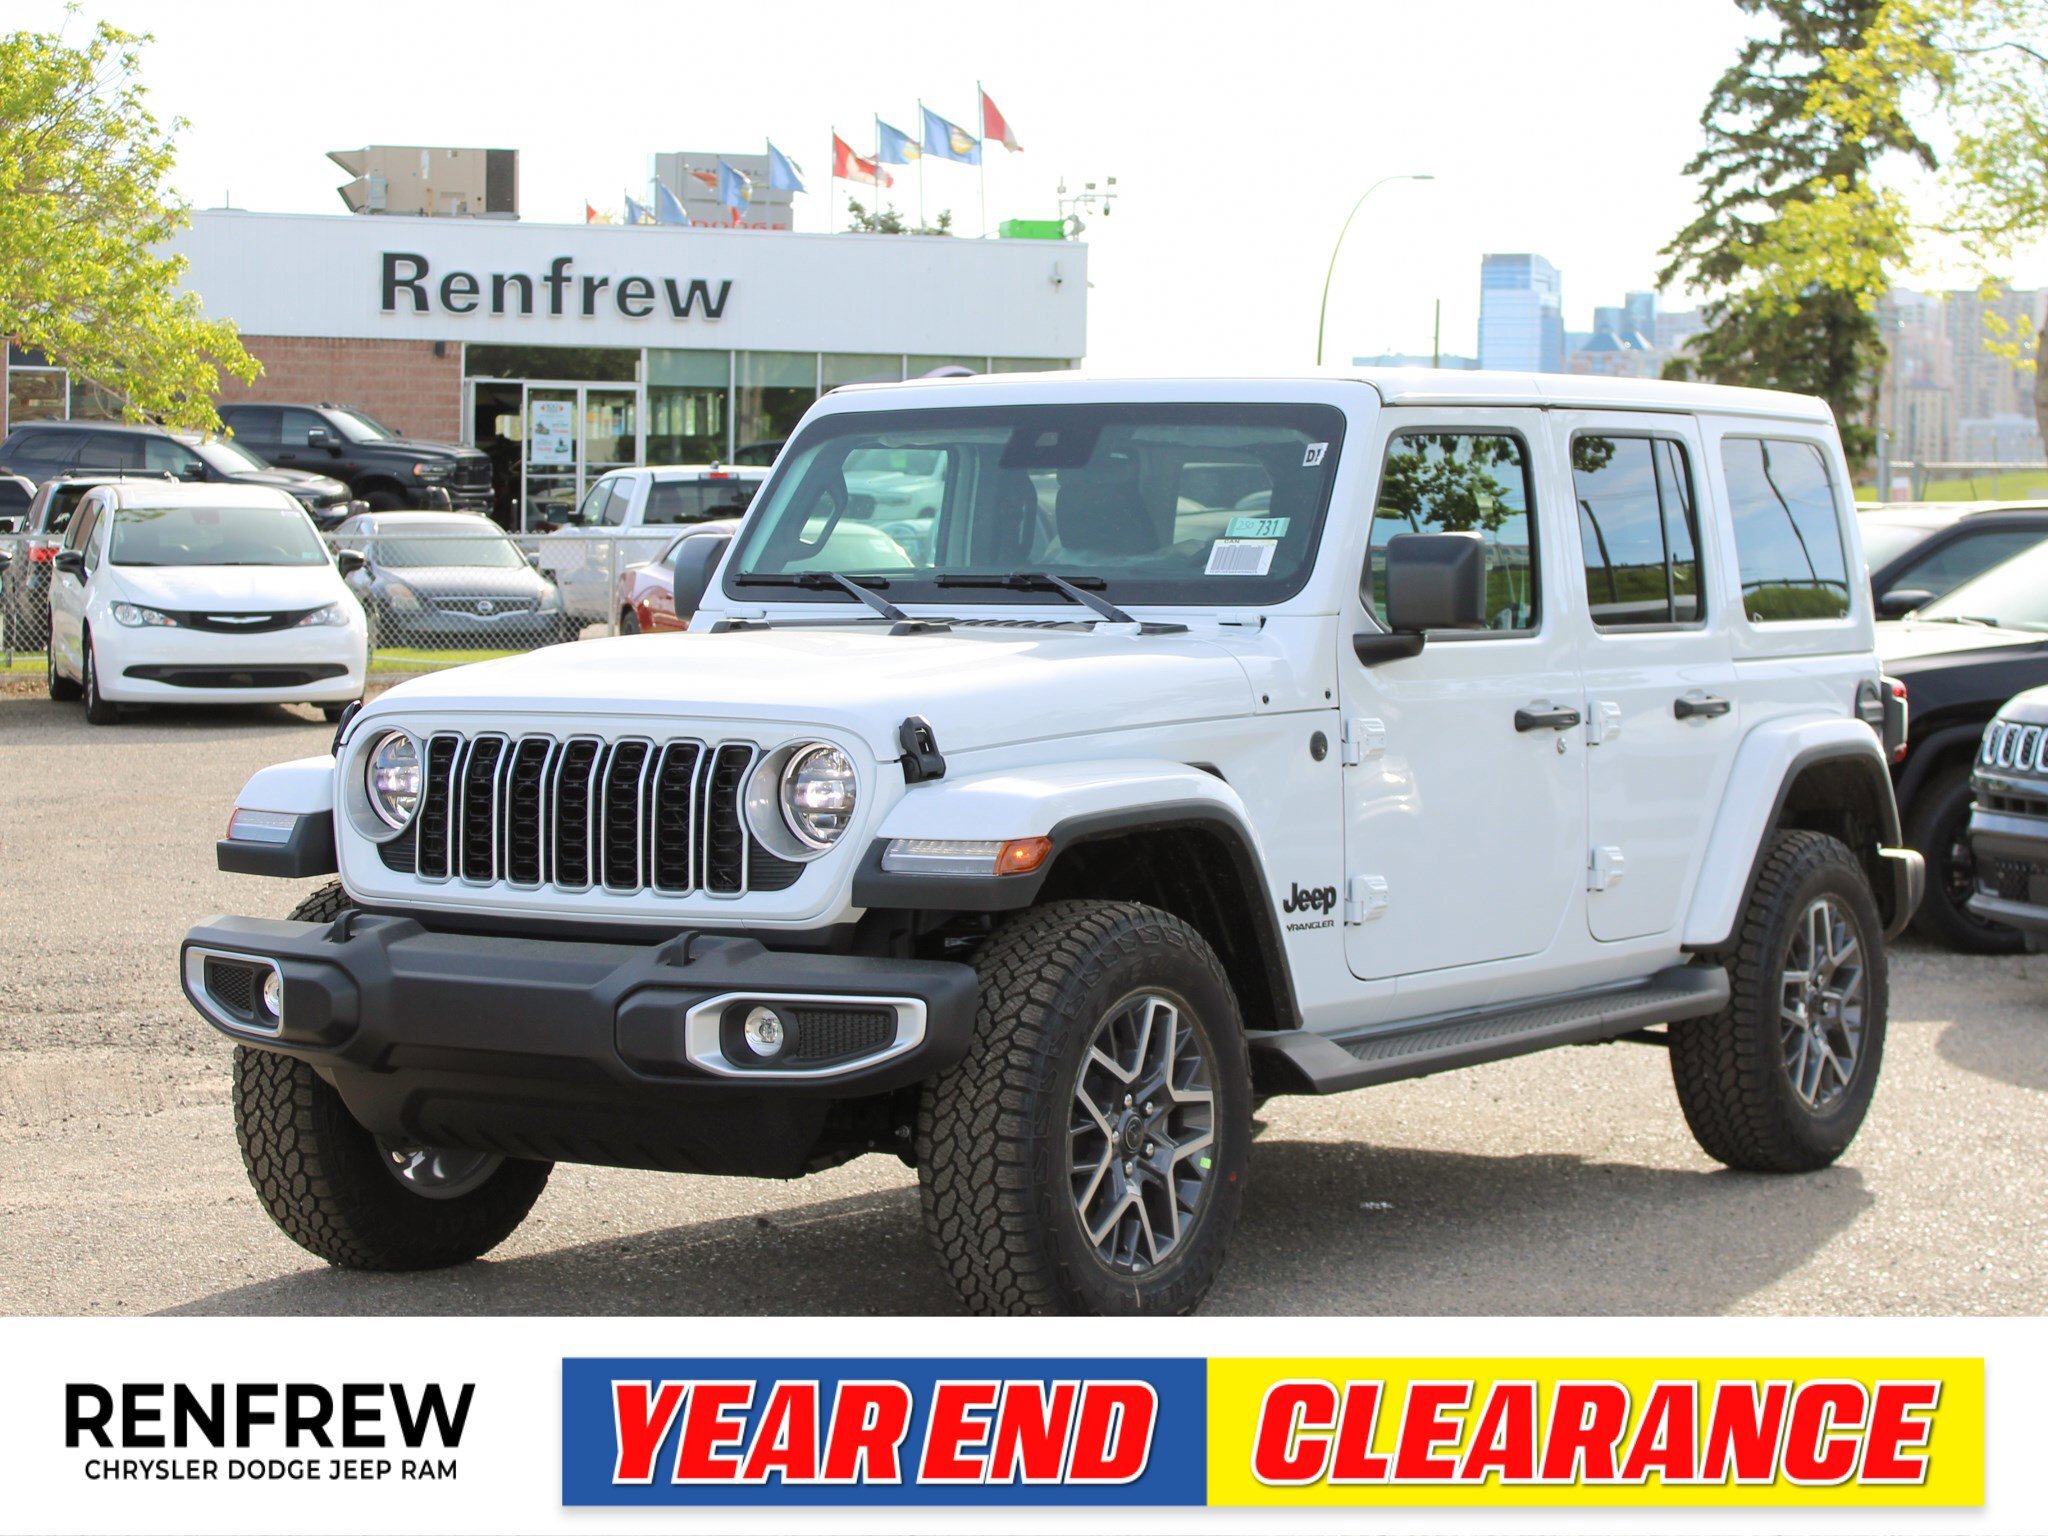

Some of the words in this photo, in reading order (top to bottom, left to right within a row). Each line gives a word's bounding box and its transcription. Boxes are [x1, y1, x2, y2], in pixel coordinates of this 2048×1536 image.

[382, 252, 732, 318] Renfrew
[1256, 519, 1280, 536] 731
[1283, 881, 1337, 915] Jeep
[1286, 919, 1335, 932] WRANGLER
